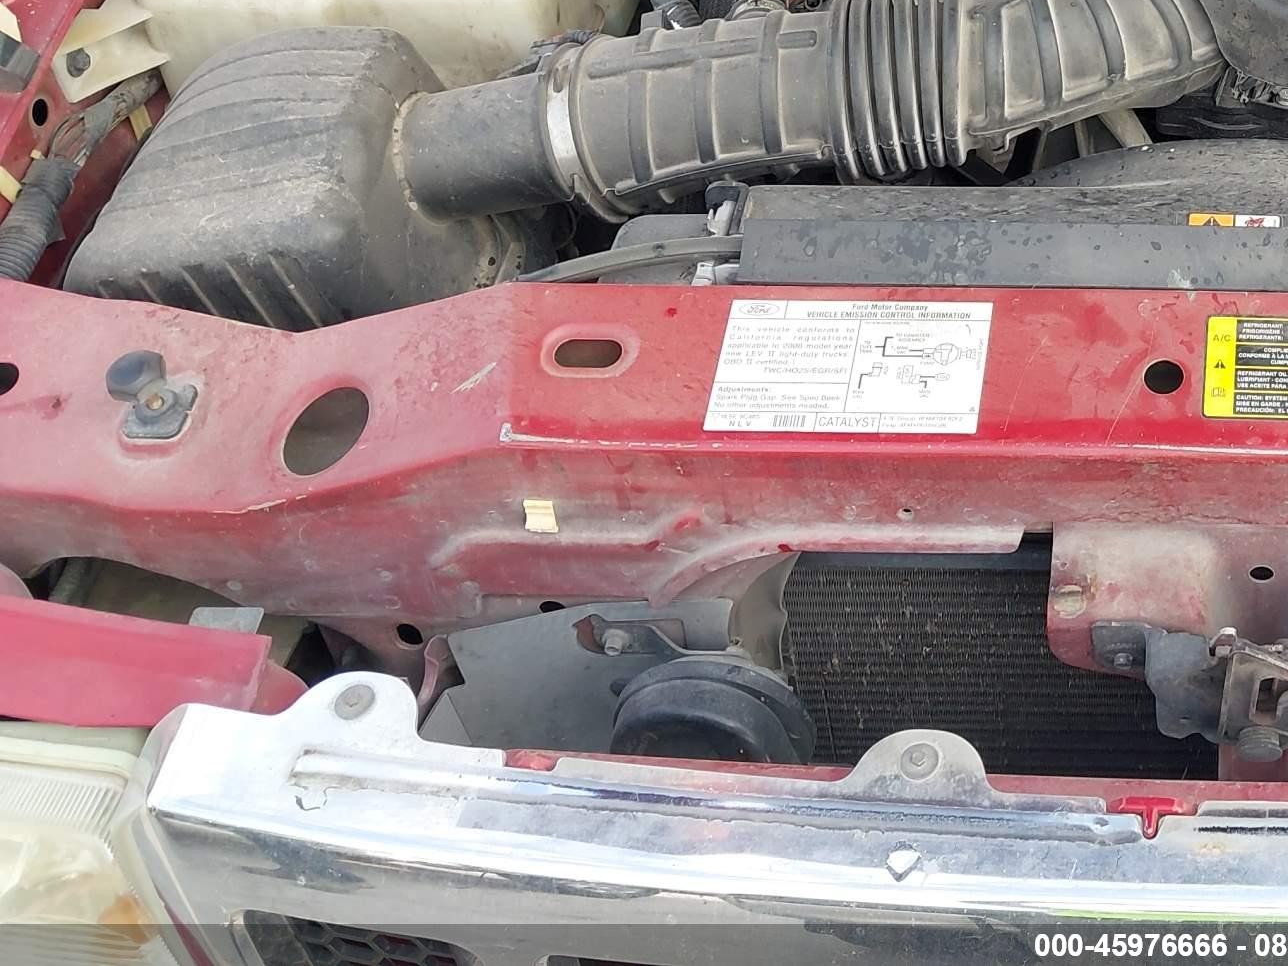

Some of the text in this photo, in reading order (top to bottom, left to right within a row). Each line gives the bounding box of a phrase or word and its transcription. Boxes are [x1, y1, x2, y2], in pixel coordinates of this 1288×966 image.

[746, 305, 770, 314] Ford
[1213, 334, 1231, 343] A/C
[818, 416, 878, 427] CATALYST
